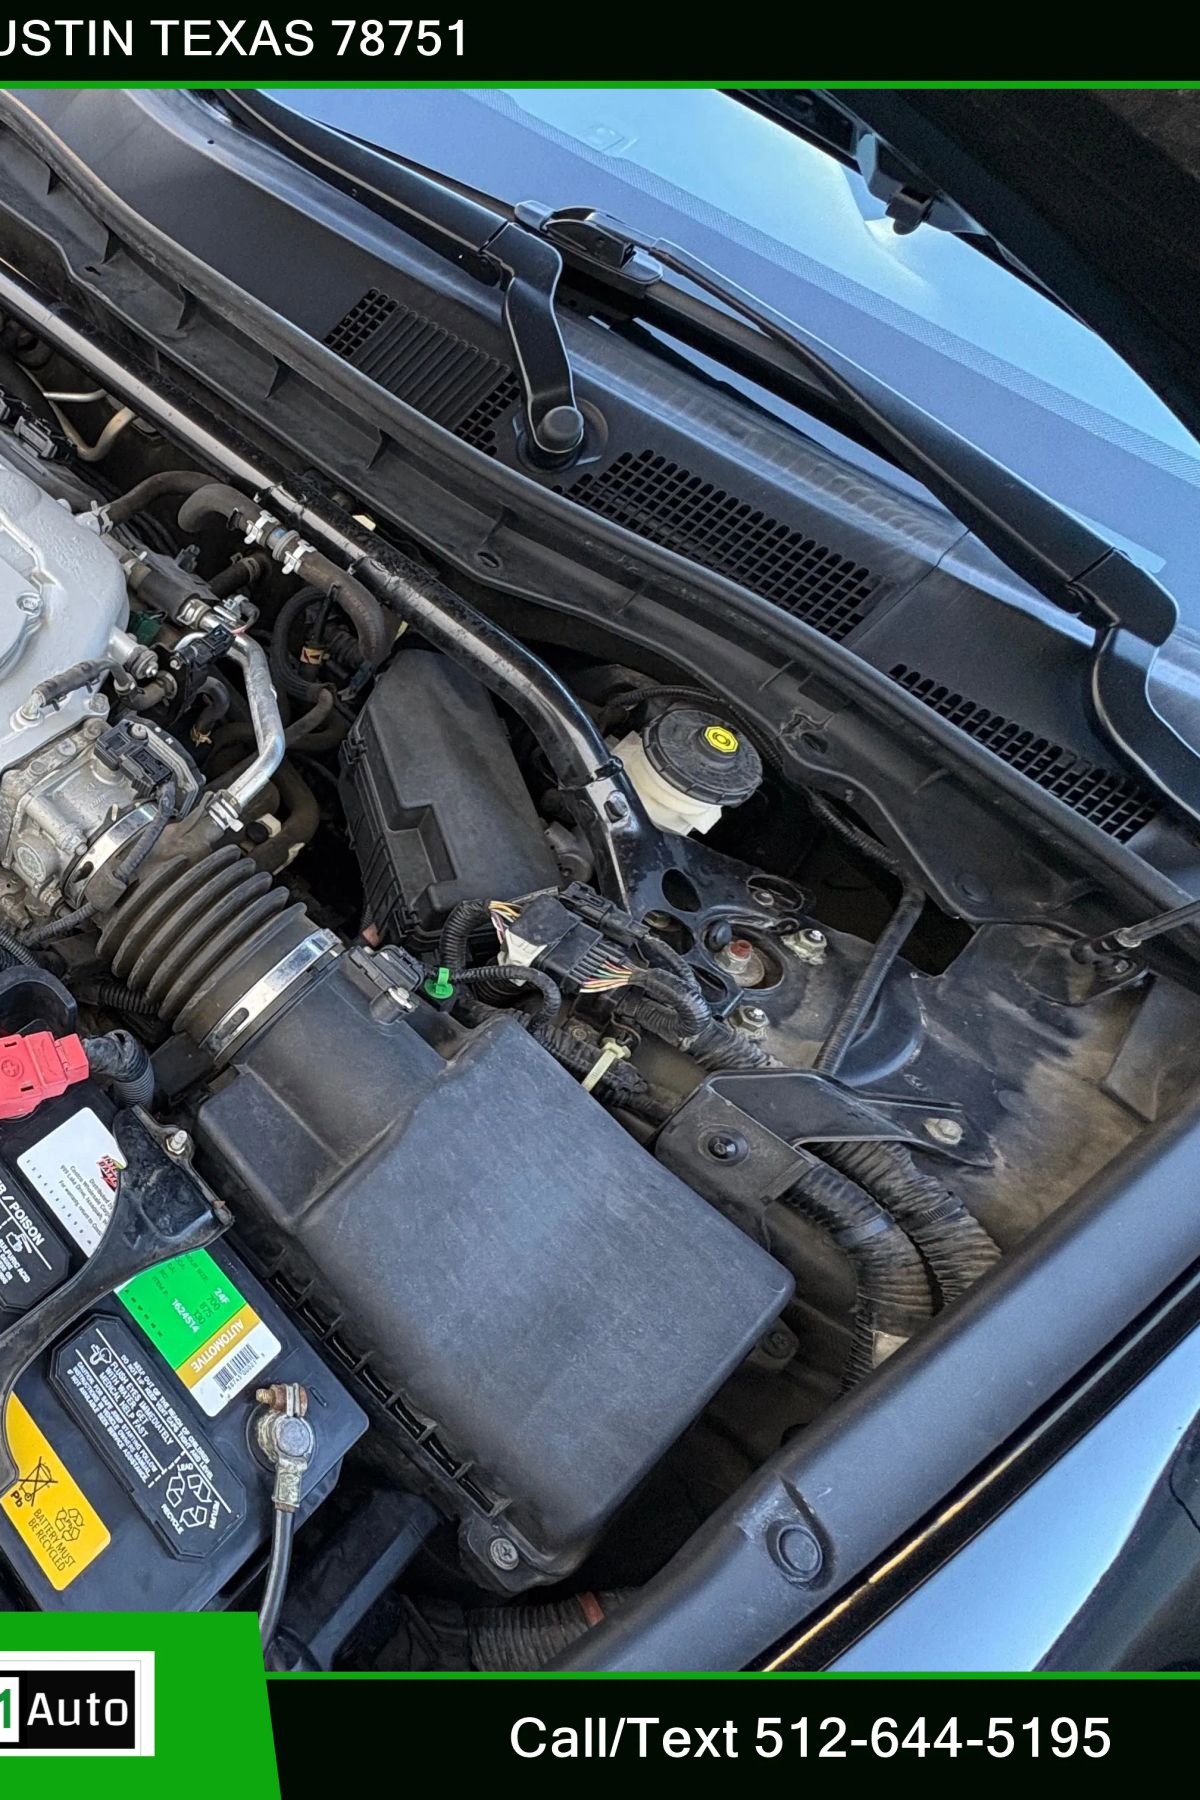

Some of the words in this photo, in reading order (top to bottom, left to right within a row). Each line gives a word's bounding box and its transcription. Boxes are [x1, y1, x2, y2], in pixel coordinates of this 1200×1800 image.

[66, 1172, 78, 1185] Lake
[1, 1191, 14, 1204] /
[8, 1200, 45, 1247] POISON
[16, 1266, 31, 1283] ACID
[205, 1294, 221, 1311] 700
[213, 1286, 230, 1306] 24F
[169, 1297, 200, 1334] 1624514
[188, 1318, 247, 1373] AUTOMOTIVE
[97, 1371, 122, 1402] MEDICAL
[118, 1400, 136, 1422] HELP
[131, 1418, 149, 1438] FAST
[103, 1366, 120, 1386] WITH
[134, 1409, 149, 1425] GET
[108, 1360, 129, 1385] FLUSH
[124, 1382, 142, 1403] EYES
[137, 1399, 174, 1446] IMMEDIATELY
[143, 1375, 155, 1389] OUT
[151, 1387, 161, 1398] OF
[157, 1395, 170, 1410] THE
[176, 1462, 194, 1472] LEAD
[8, 1489, 25, 1508] Pb
[32, 1507, 60, 1544] BATTERY
[55, 1542, 76, 1567] MUST
[161, 1503, 184, 1535] RECYCLE
[26, 1517, 40, 1531] BE
[34, 1528, 67, 1572] RECYCLED
